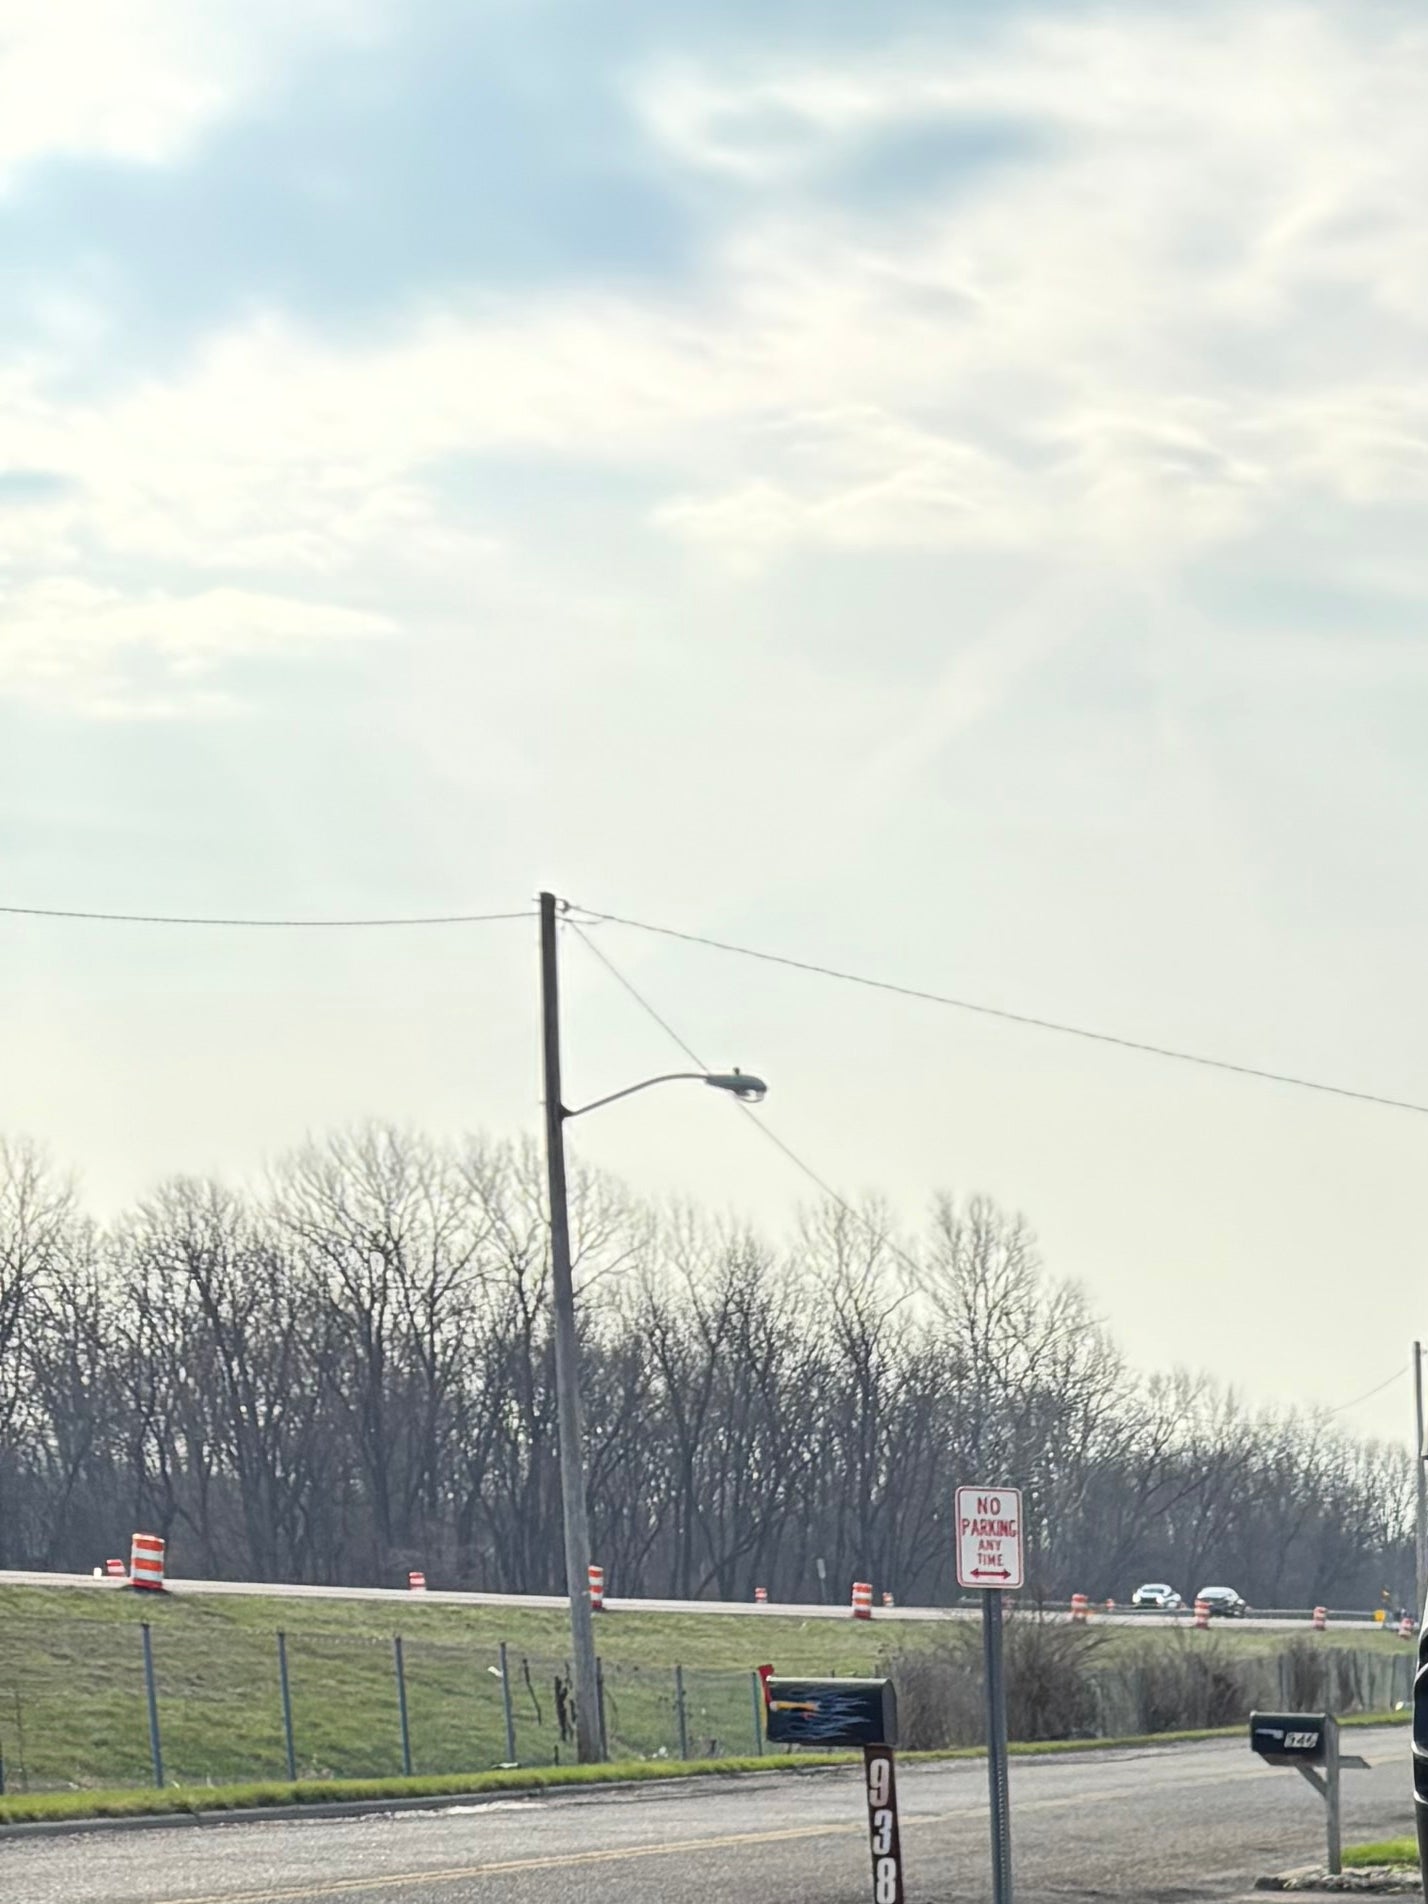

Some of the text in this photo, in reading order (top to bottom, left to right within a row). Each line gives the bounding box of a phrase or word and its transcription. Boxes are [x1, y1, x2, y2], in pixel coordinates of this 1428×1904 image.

[977, 1497, 1001, 1516] NO
[961, 1518, 1017, 1537] PARKING
[978, 1540, 1002, 1551] ANY
[977, 1553, 1004, 1566] TIME
[869, 1758, 897, 1904] 938
